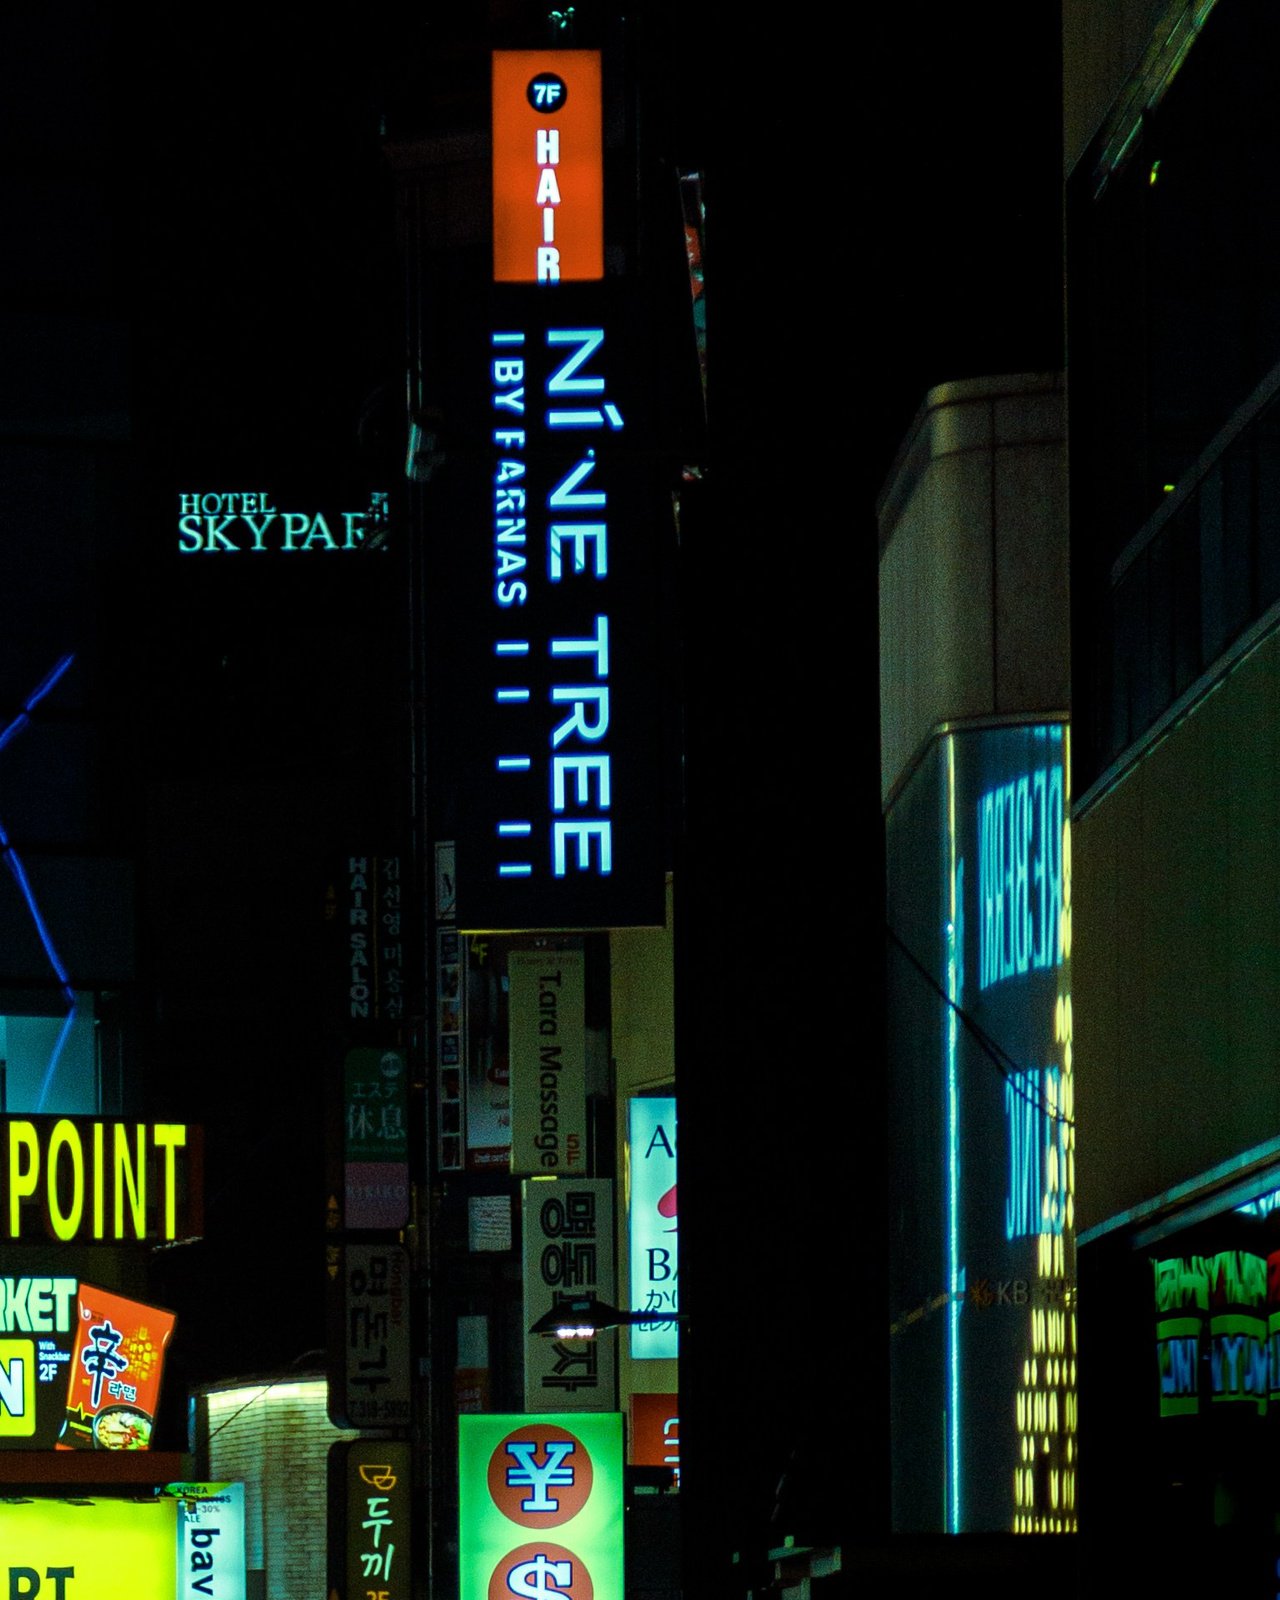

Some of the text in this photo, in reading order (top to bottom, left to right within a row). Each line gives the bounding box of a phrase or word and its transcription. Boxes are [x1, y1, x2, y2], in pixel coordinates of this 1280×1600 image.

[533, 83, 562, 104] 7F
[535, 129, 562, 284] HAIR
[494, 360, 525, 412] BY
[179, 492, 277, 515] HOTEL
[550, 616, 614, 879] TREE
[348, 856, 370, 1019] HAIR SALON
[534, 1046, 563, 1168] Massage
[9, 1118, 187, 1242] POINT
[541, 1192, 598, 1392] 명동자
[998, 1279, 1030, 1305] KB
[37, 1340, 56, 1351] With
[37, 1350, 71, 1363] Snackbar
[82, 1319, 129, 1409] 辛
[38, 1363, 59, 1383] 2F
[108, 1379, 138, 1403] 라면
[183, 1514, 201, 1524] ALE
